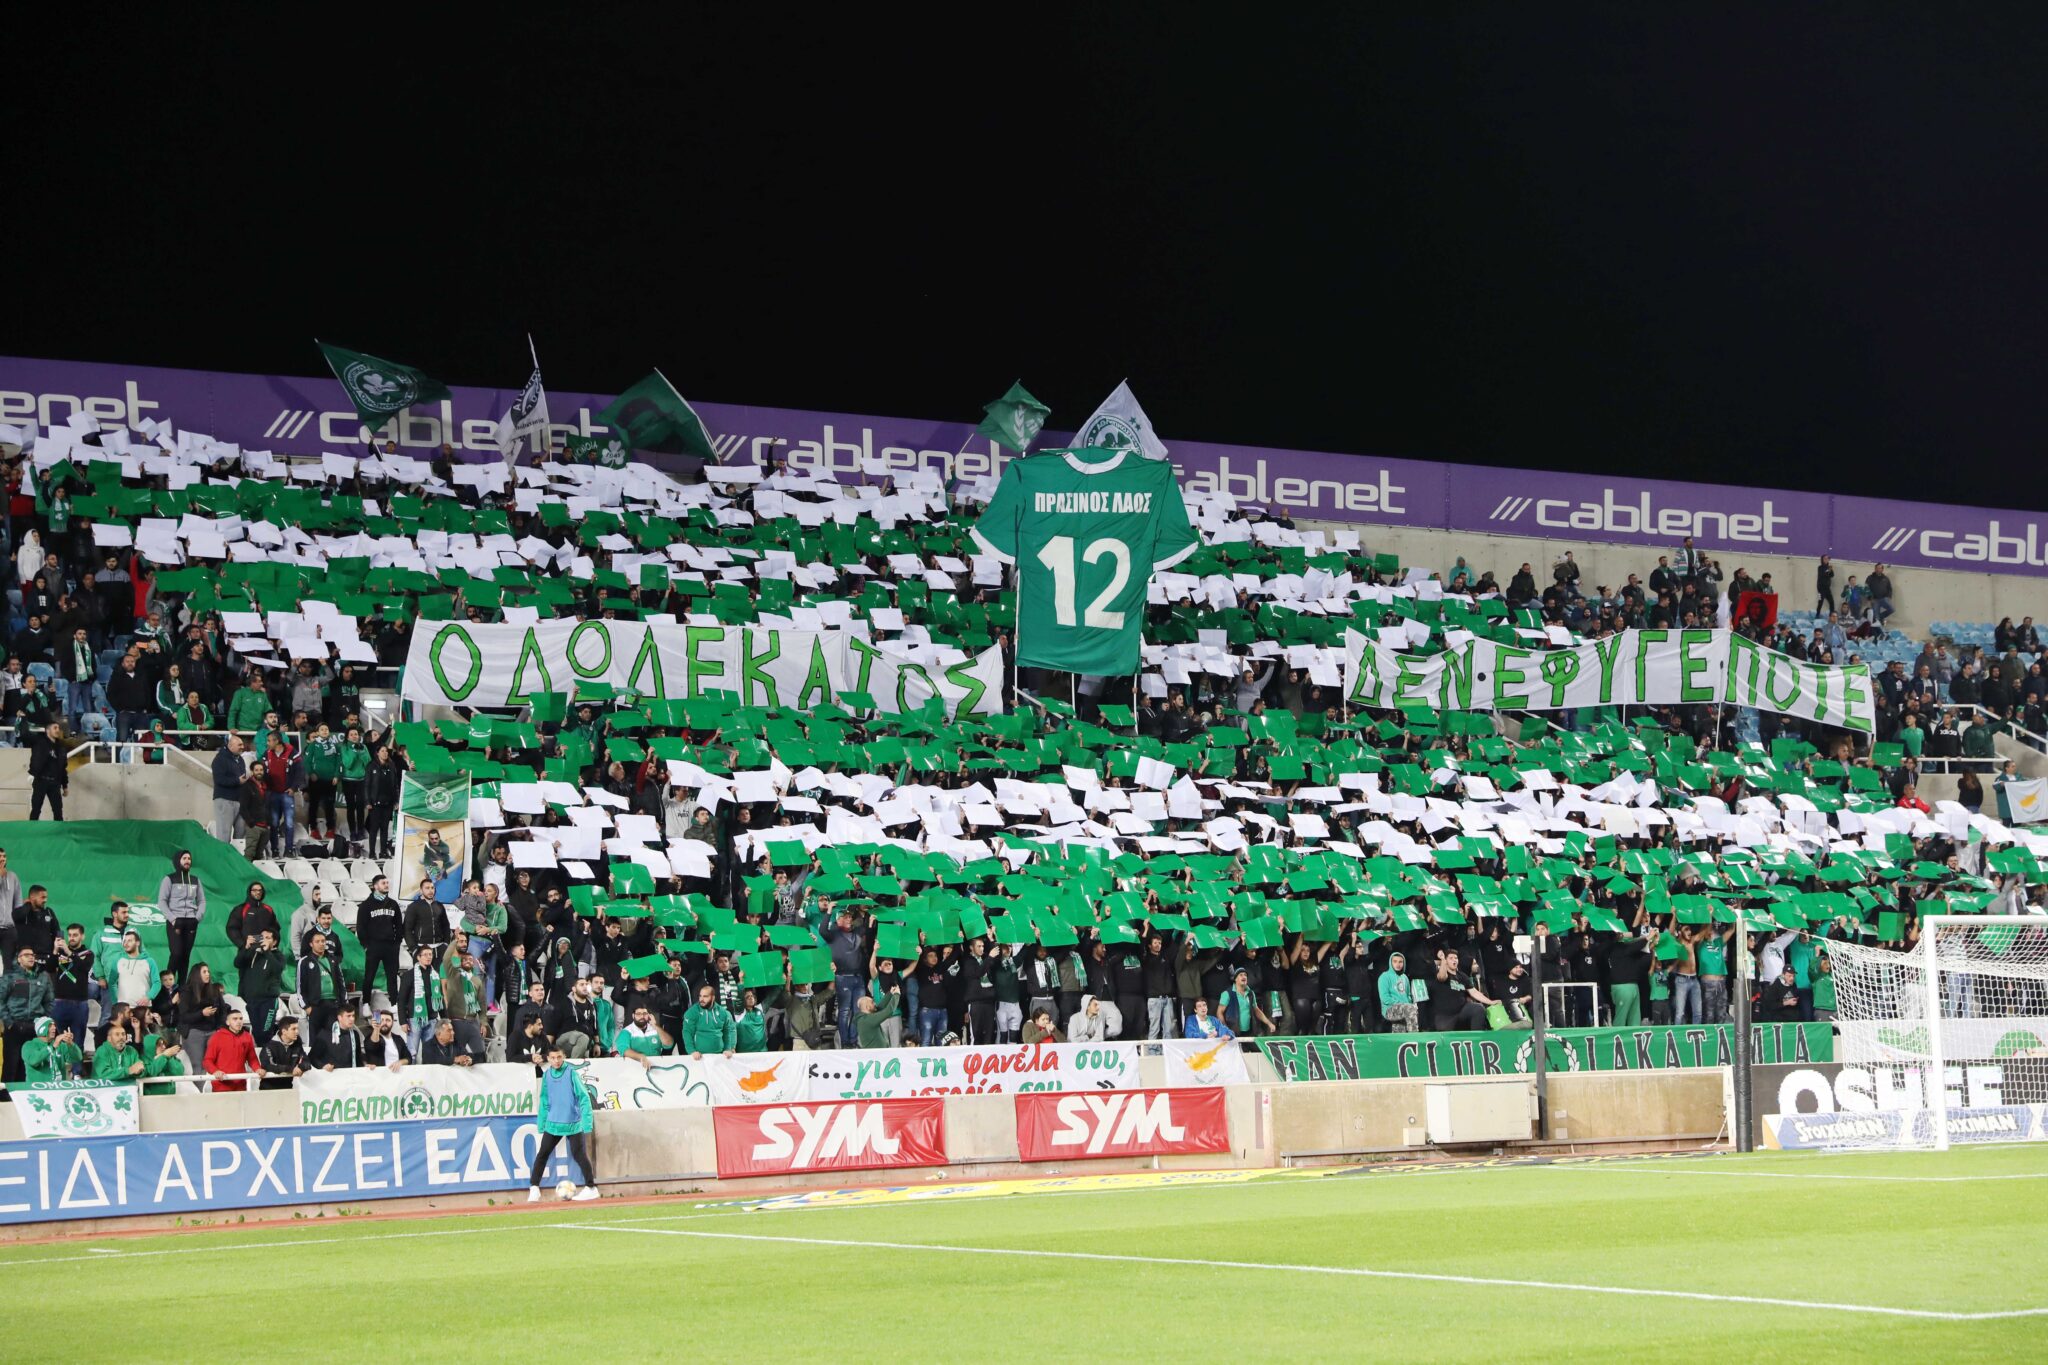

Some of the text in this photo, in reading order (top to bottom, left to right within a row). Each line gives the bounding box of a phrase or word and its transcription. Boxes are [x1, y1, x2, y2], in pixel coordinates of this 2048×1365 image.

[1035, 492, 1152, 513] ΠΡΑΣΙΝΟΣ ΛΑΟΣ
[1536, 489, 1789, 543] cablenet
[1920, 520, 2048, 567] cabl
[1036, 535, 1131, 630] 12
[429, 623, 482, 702] Ο
[1350, 630, 1873, 732] ΔΕΝ ΕΦΥΓΕ ΠΟΤΕ
[917, 1057, 947, 1077] τη
[963, 1043, 1059, 1084] φανέλα
[1075, 1049, 1126, 1076] σου,
[1265, 1039, 1361, 1081] FAN
[437, 1090, 533, 1117] ΟΜΟΝΟΙΑ
[1051, 1092, 1186, 1154] SYM
[752, 1102, 900, 1168] SYM
[153, 1132, 403, 1203] ΑΡΧΙΖΕΙ
